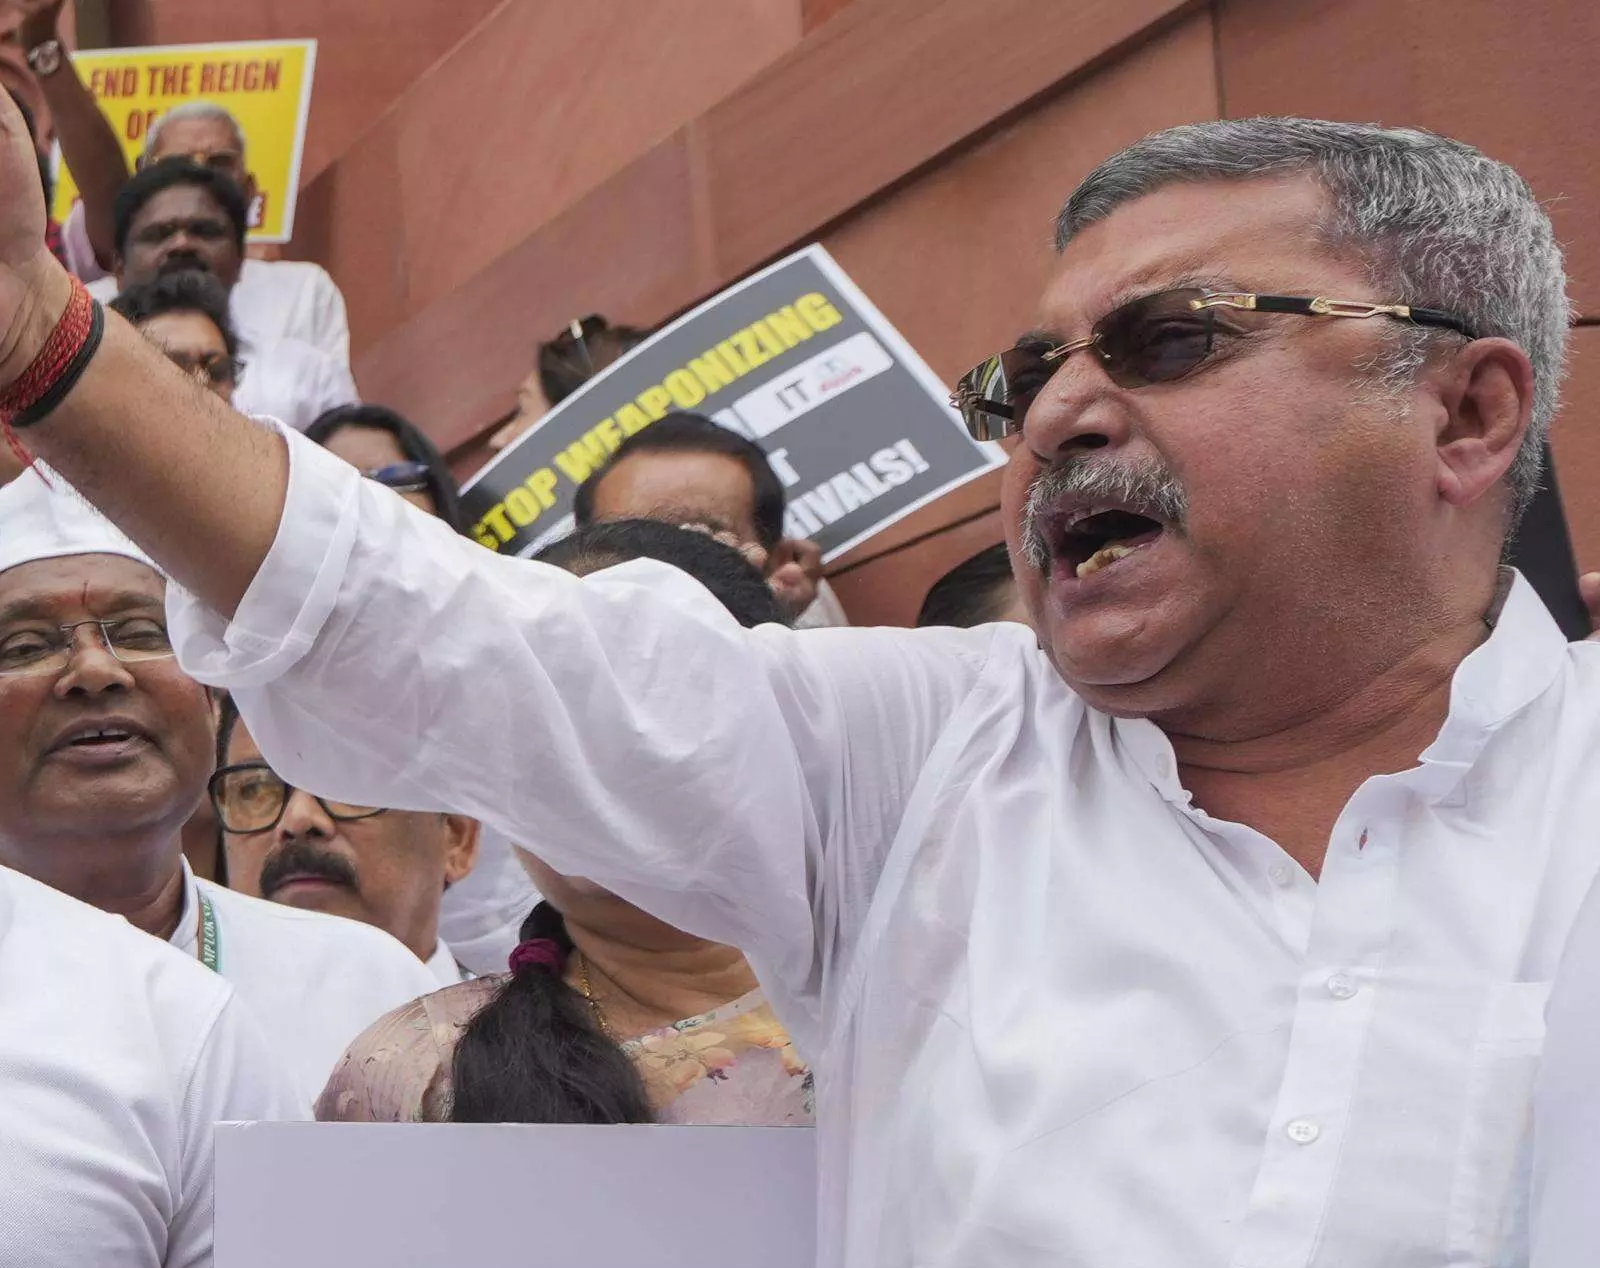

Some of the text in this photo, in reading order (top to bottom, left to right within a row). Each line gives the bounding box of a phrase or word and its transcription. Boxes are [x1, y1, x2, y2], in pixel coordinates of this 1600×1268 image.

[91, 59, 282, 98] END THE REIGN
[553, 292, 844, 486] WEAPONIZING
